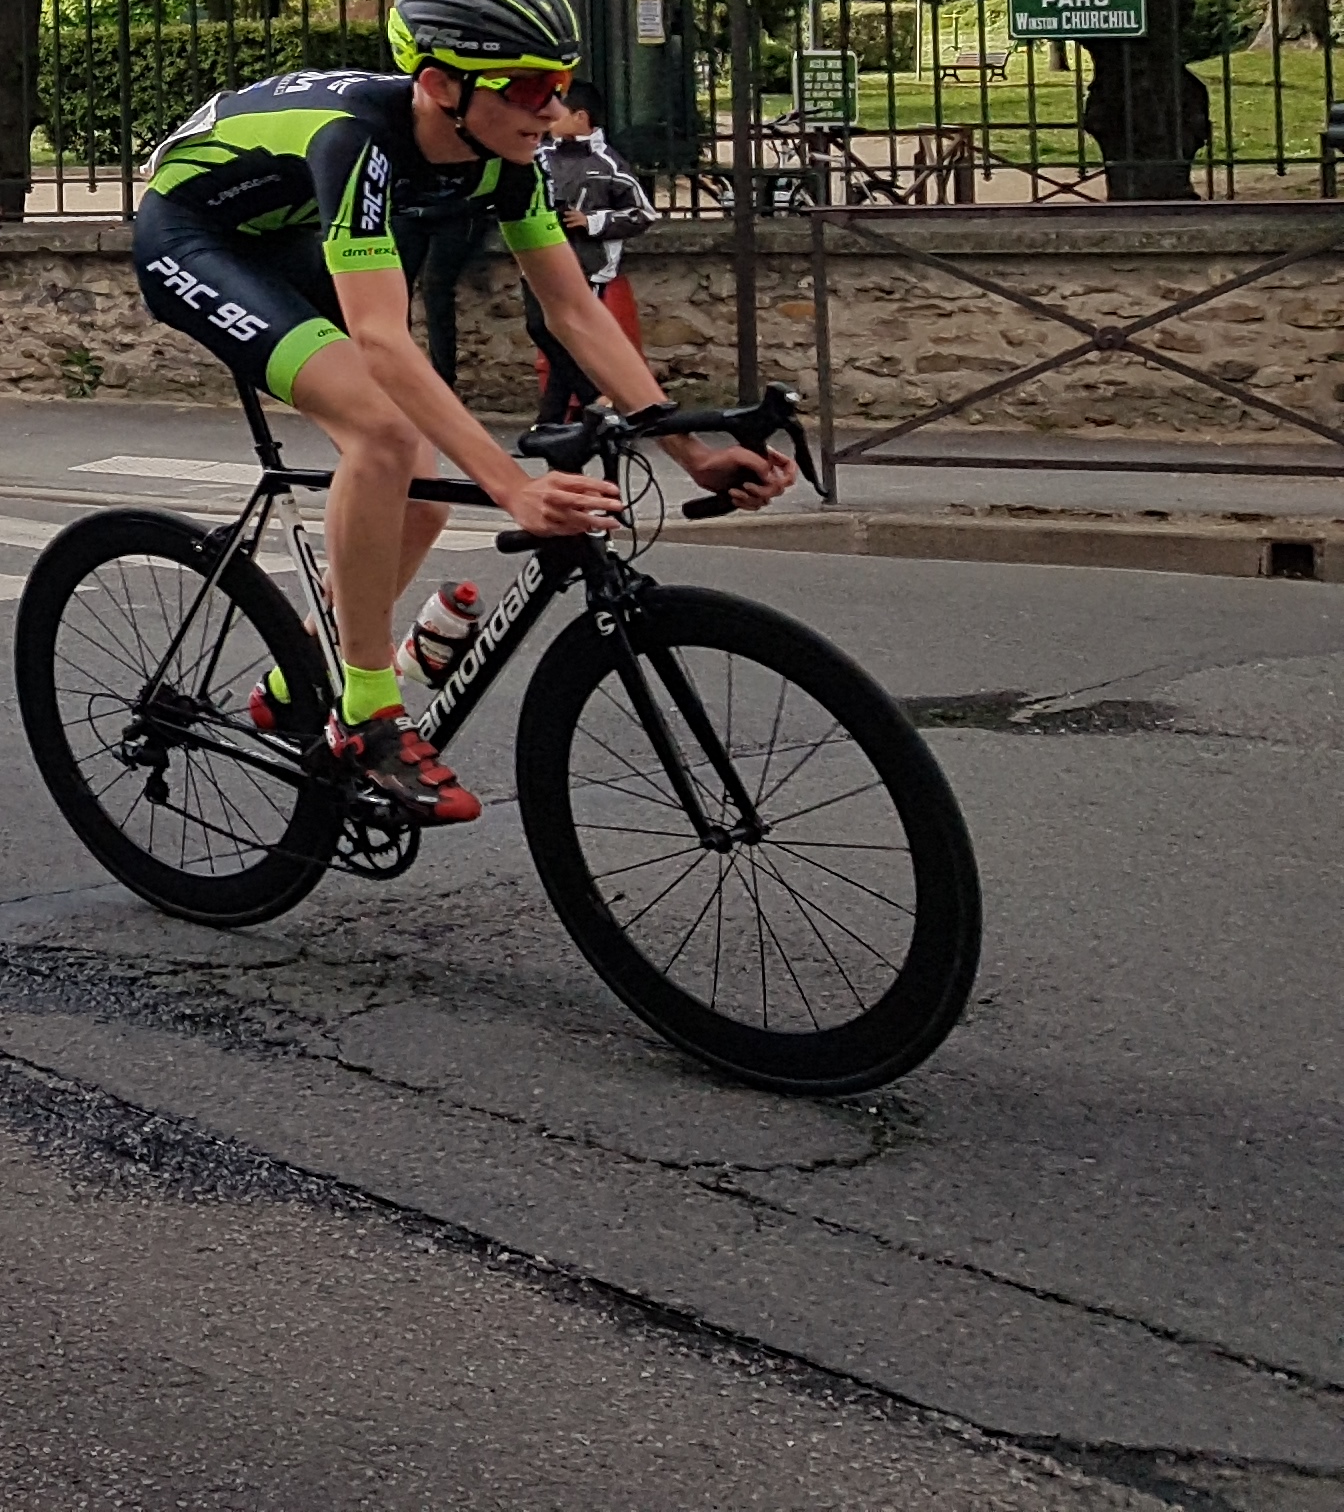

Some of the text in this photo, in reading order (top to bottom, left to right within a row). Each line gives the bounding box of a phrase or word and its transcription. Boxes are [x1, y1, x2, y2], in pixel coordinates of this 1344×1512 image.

[1062, 10, 1139, 29] CHURCHILL
[360, 145, 389, 230] PAC 95
[146, 256, 269, 341] PAC 95
[418, 557, 544, 741] annondale
